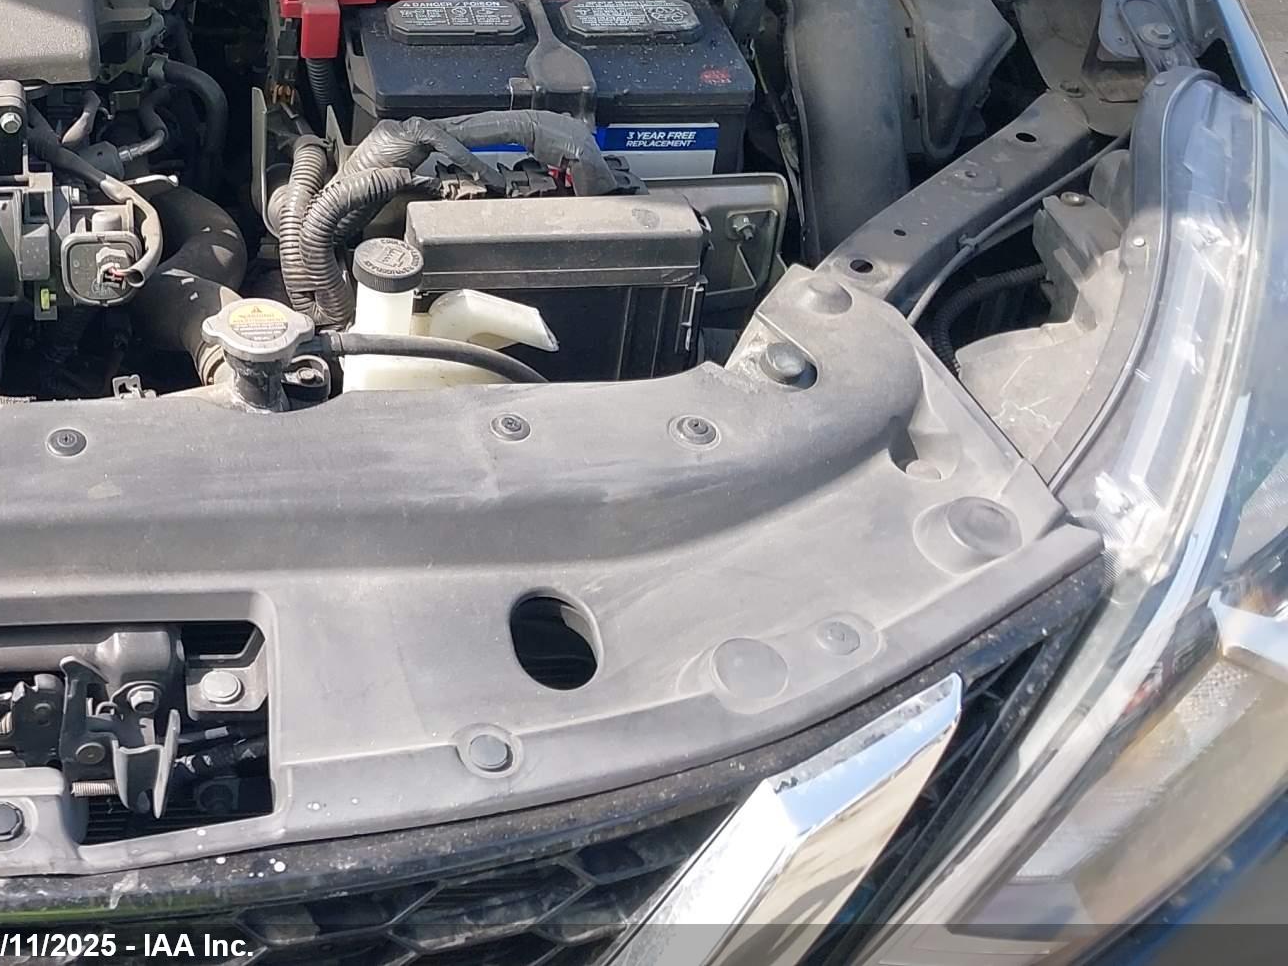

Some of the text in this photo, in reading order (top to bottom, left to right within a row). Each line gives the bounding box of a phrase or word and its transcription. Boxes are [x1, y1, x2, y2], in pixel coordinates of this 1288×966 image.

[626, 131, 697, 140] 3 YEAR FREE
